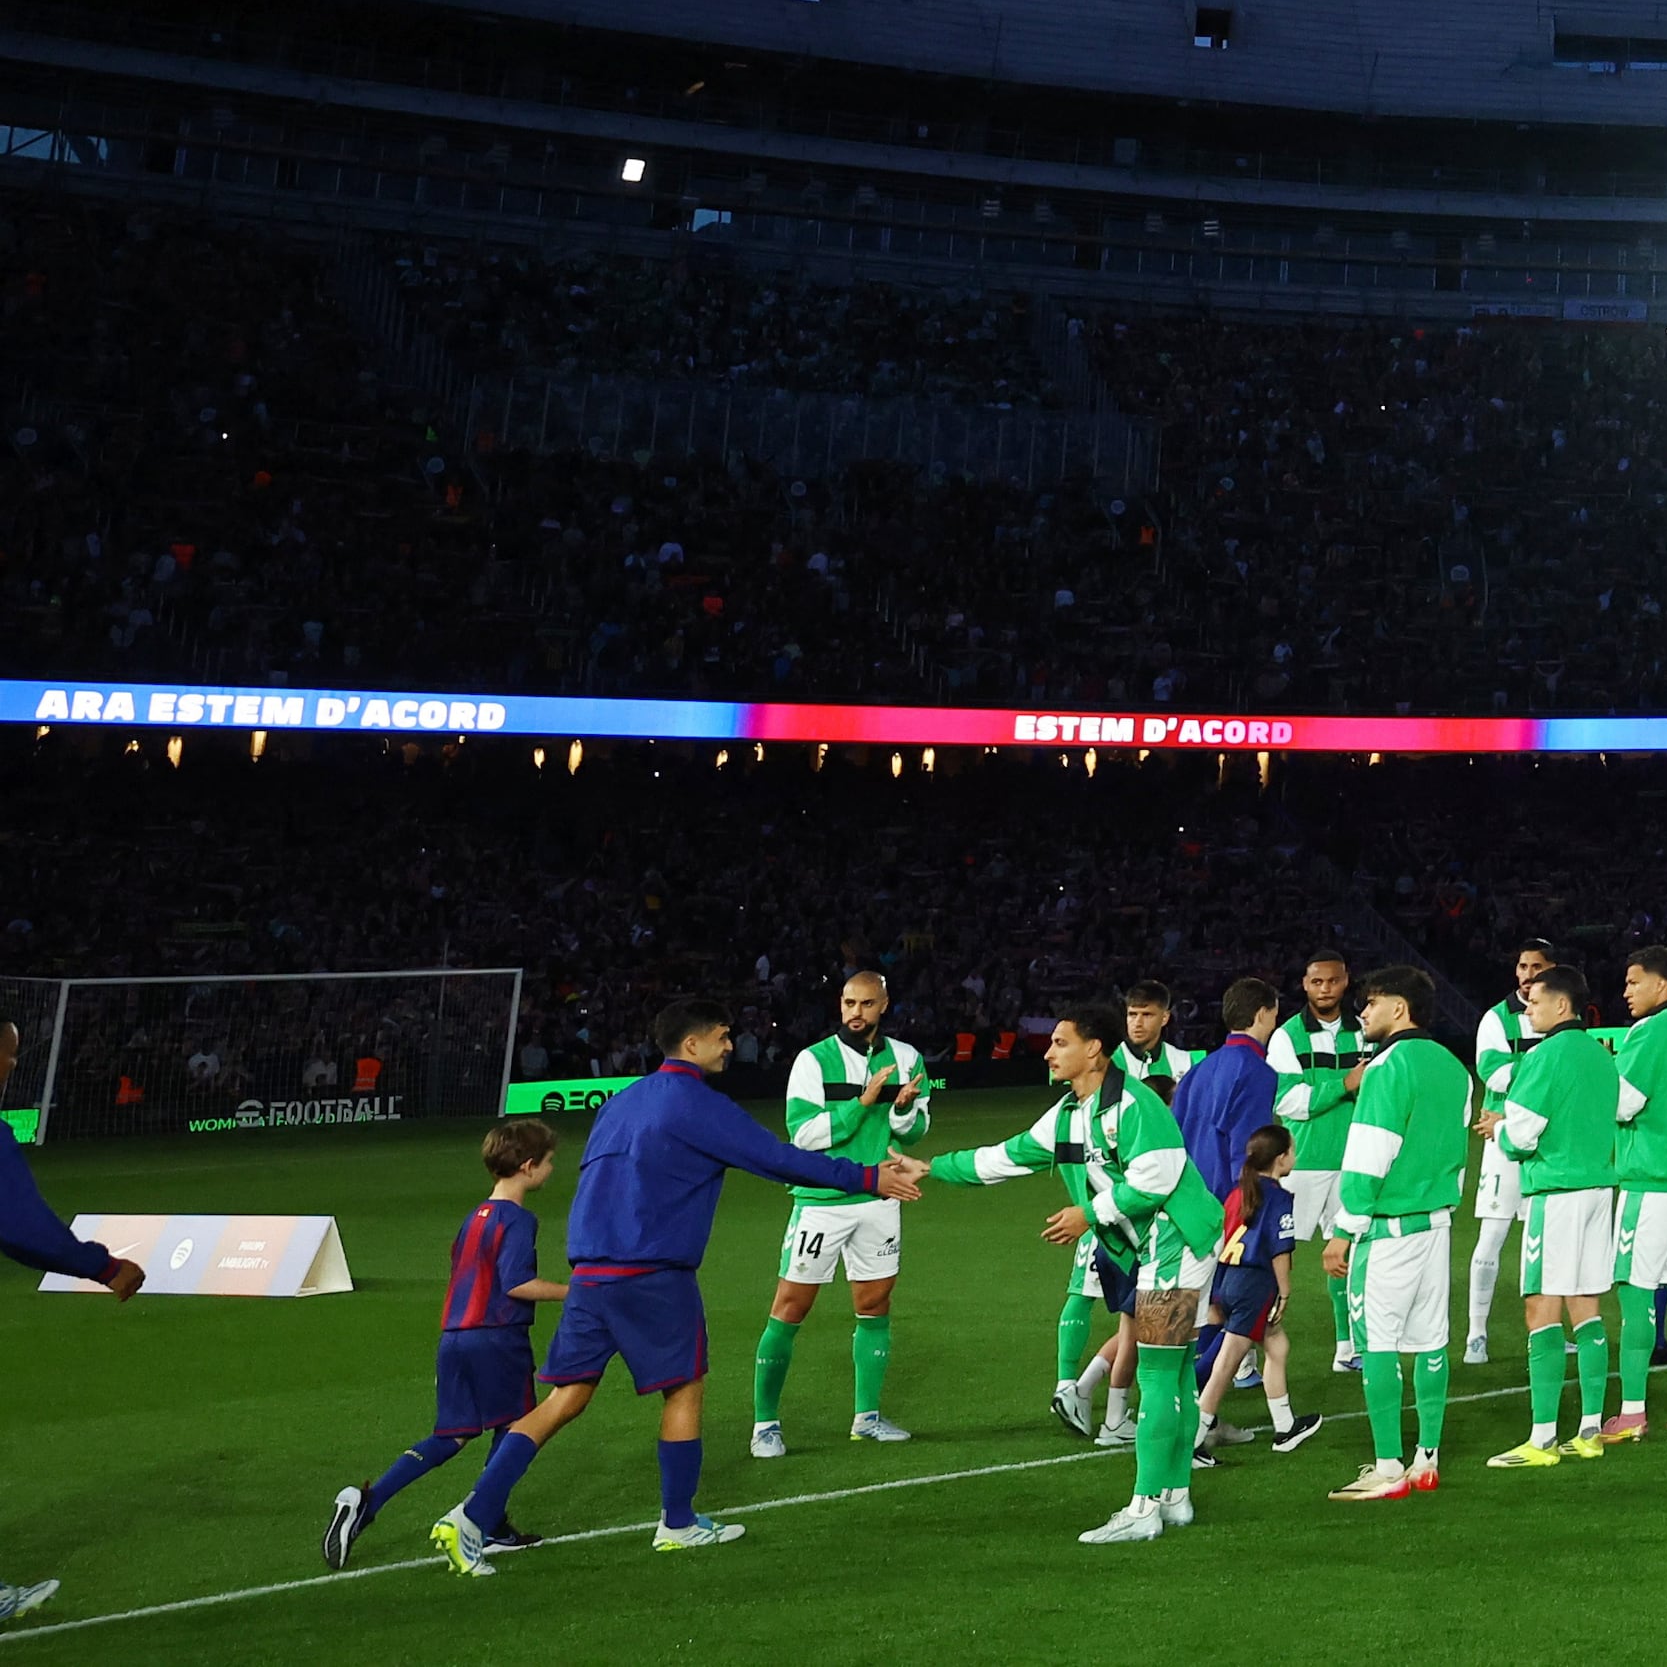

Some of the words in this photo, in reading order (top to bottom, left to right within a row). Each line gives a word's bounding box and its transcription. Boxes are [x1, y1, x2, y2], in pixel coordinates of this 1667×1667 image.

[35, 689, 135, 721] ARA
[148, 693, 304, 726] ESTEM
[1014, 714, 1135, 743] ESTEM
[1494, 1174, 1501, 1197] 1
[797, 1230, 824, 1259] 14
